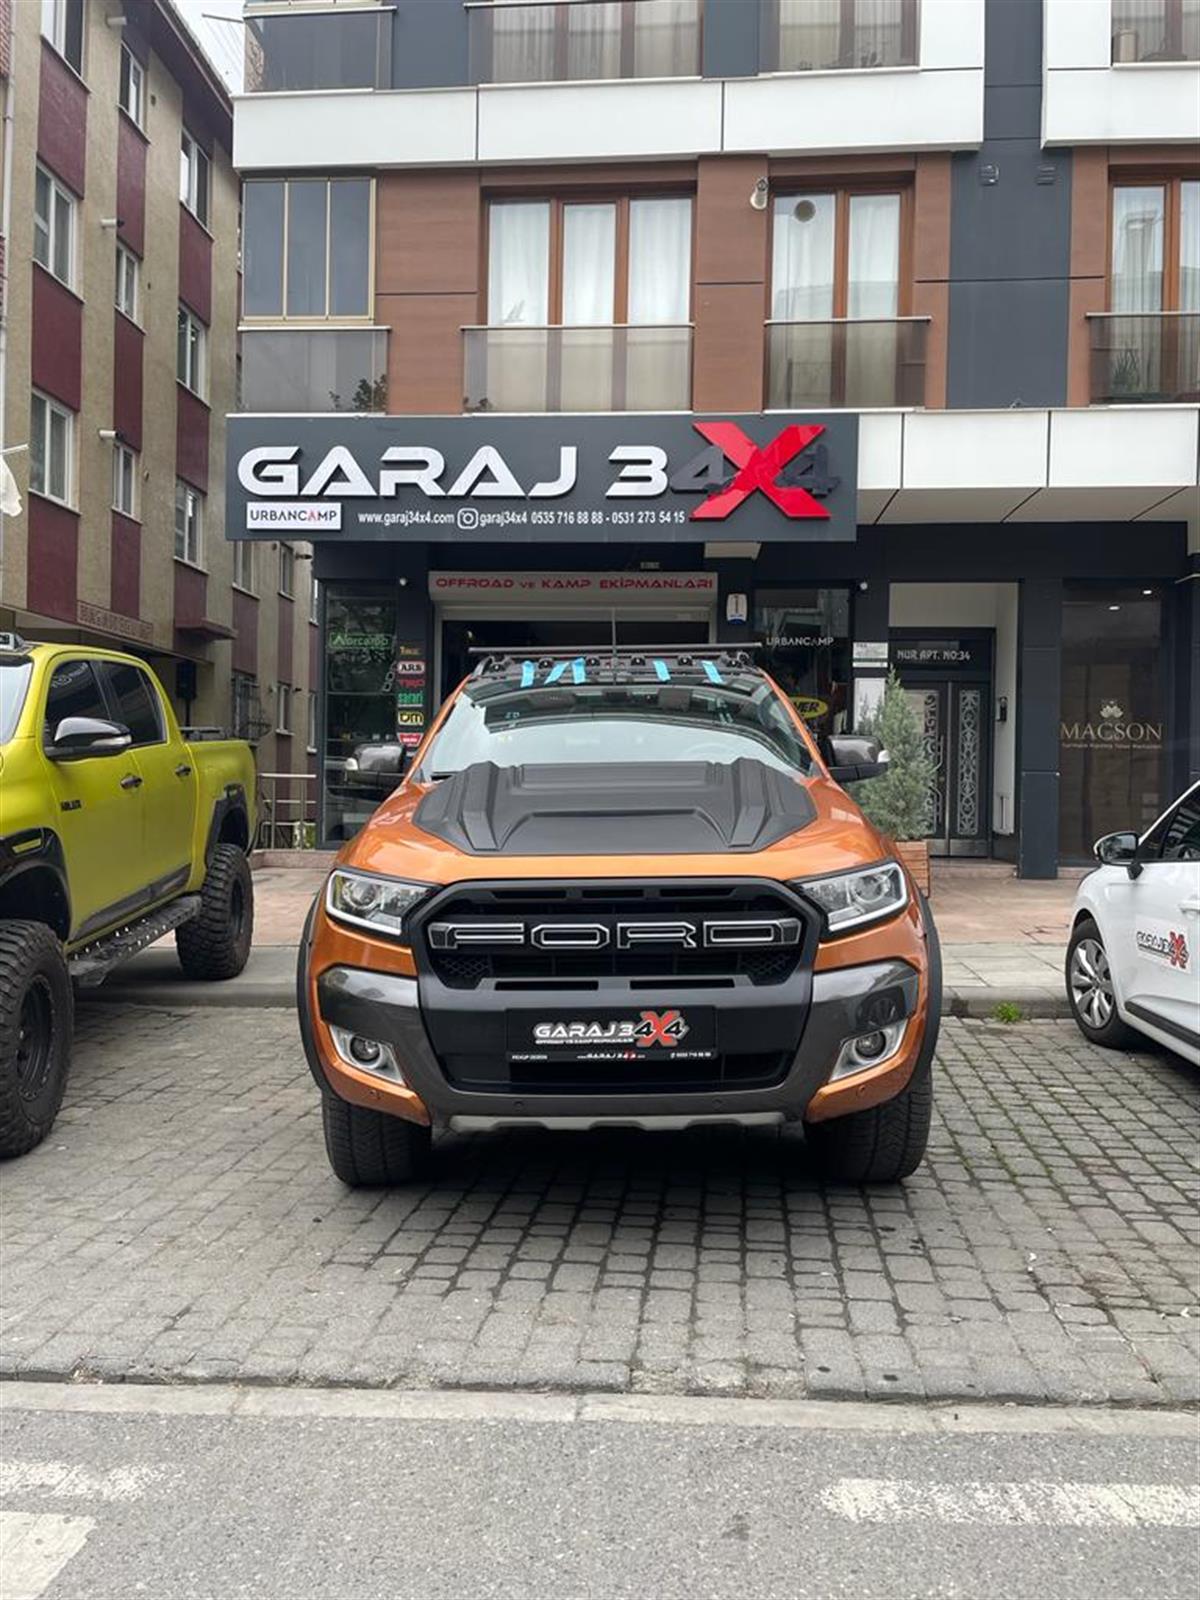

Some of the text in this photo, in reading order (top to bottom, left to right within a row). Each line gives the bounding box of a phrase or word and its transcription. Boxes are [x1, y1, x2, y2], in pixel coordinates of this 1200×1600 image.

[237, 445, 577, 497] GARAJ
[250, 509, 337, 522] URBANCAMP
[358, 510, 455, 527] www.garaj34x4.com
[479, 510, 528, 527] garaj34x4
[531, 511, 554, 524] 0535
[557, 511, 575, 524] 716
[577, 511, 589, 524] 88
[591, 511, 603, 524] 88
[611, 511, 634, 524] 0531
[637, 511, 656, 524] 273
[659, 511, 671, 524] 54
[674, 511, 685, 524] 15
[436, 578, 514, 588] OFFROAD
[541, 577, 592, 588] KAMP
[766, 636, 834, 646] URBANCAMP
[1060, 722, 1163, 741] MACSON
[427, 917, 802, 950] FORD
[533, 1022, 617, 1039] GARAJ
